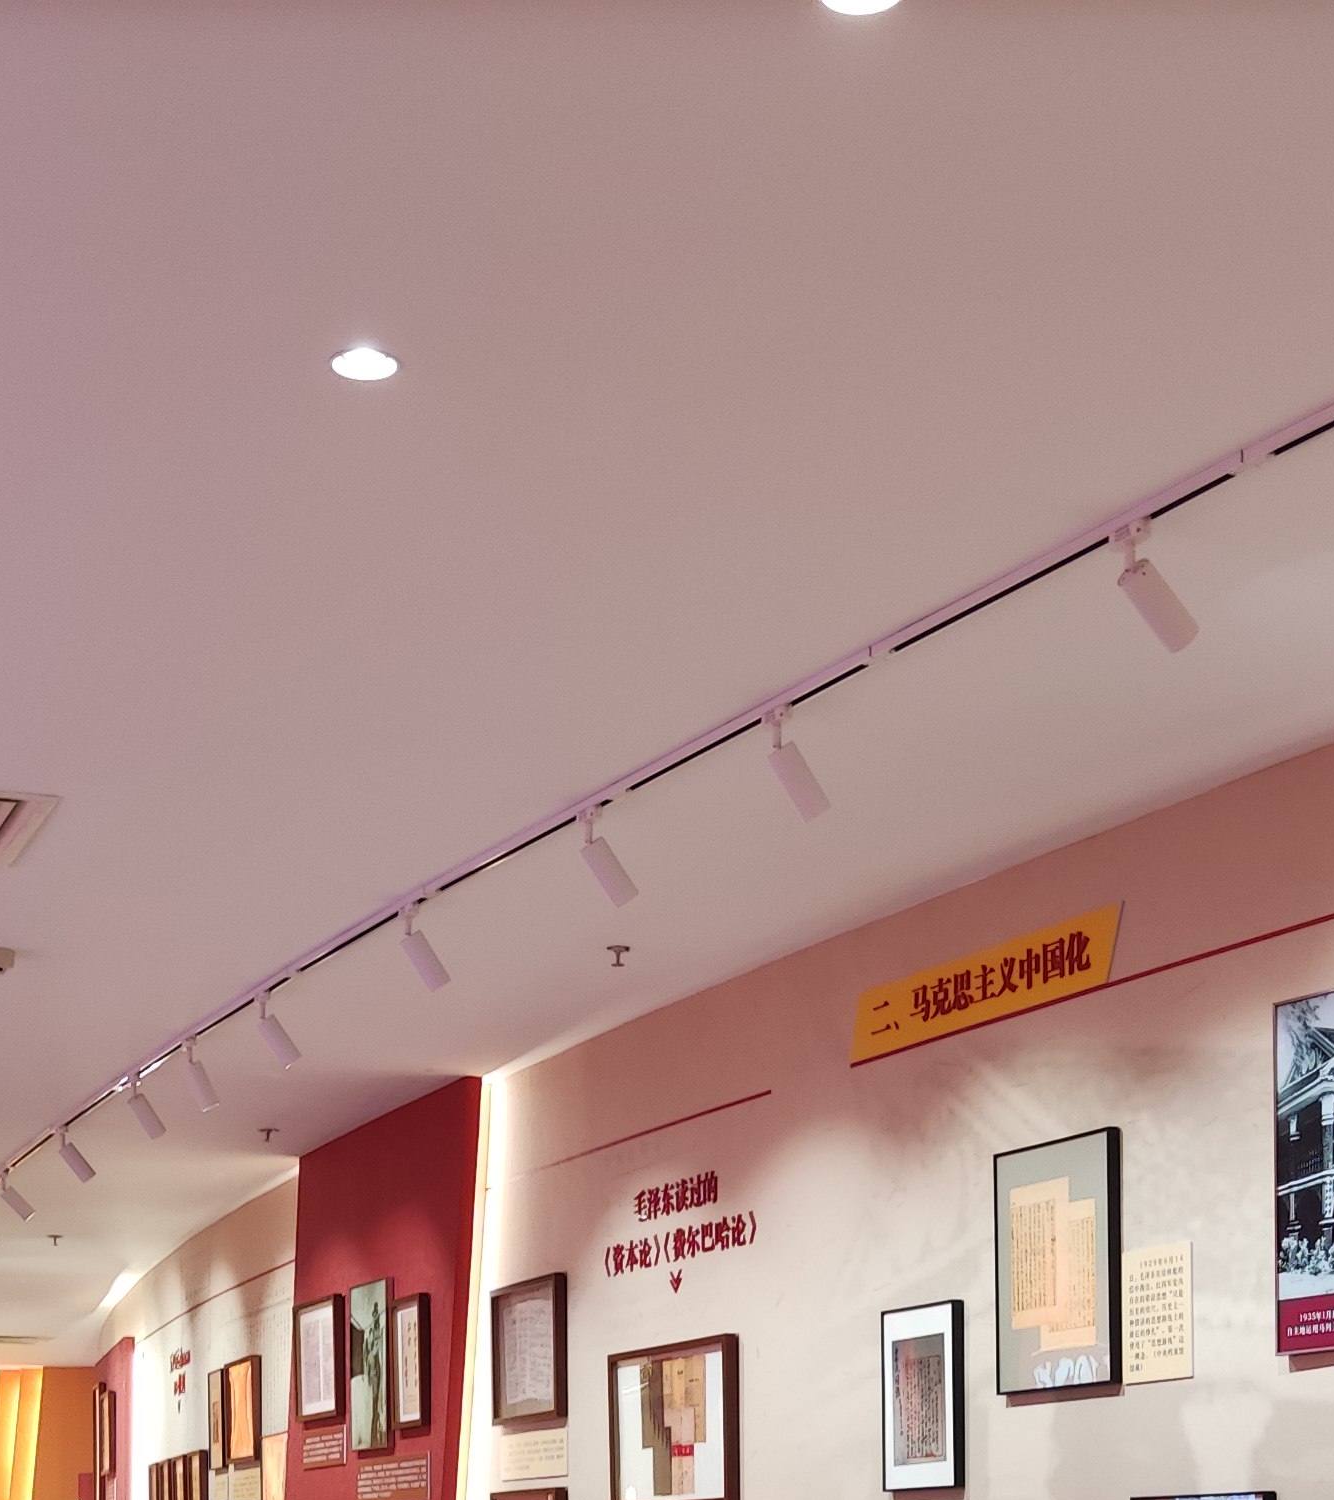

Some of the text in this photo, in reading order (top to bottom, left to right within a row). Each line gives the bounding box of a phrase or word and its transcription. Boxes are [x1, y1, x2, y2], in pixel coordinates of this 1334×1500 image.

[870, 931, 1092, 1036] 二、马克思主义中国化
[633, 1170, 719, 1222] 毛泽东读过的
